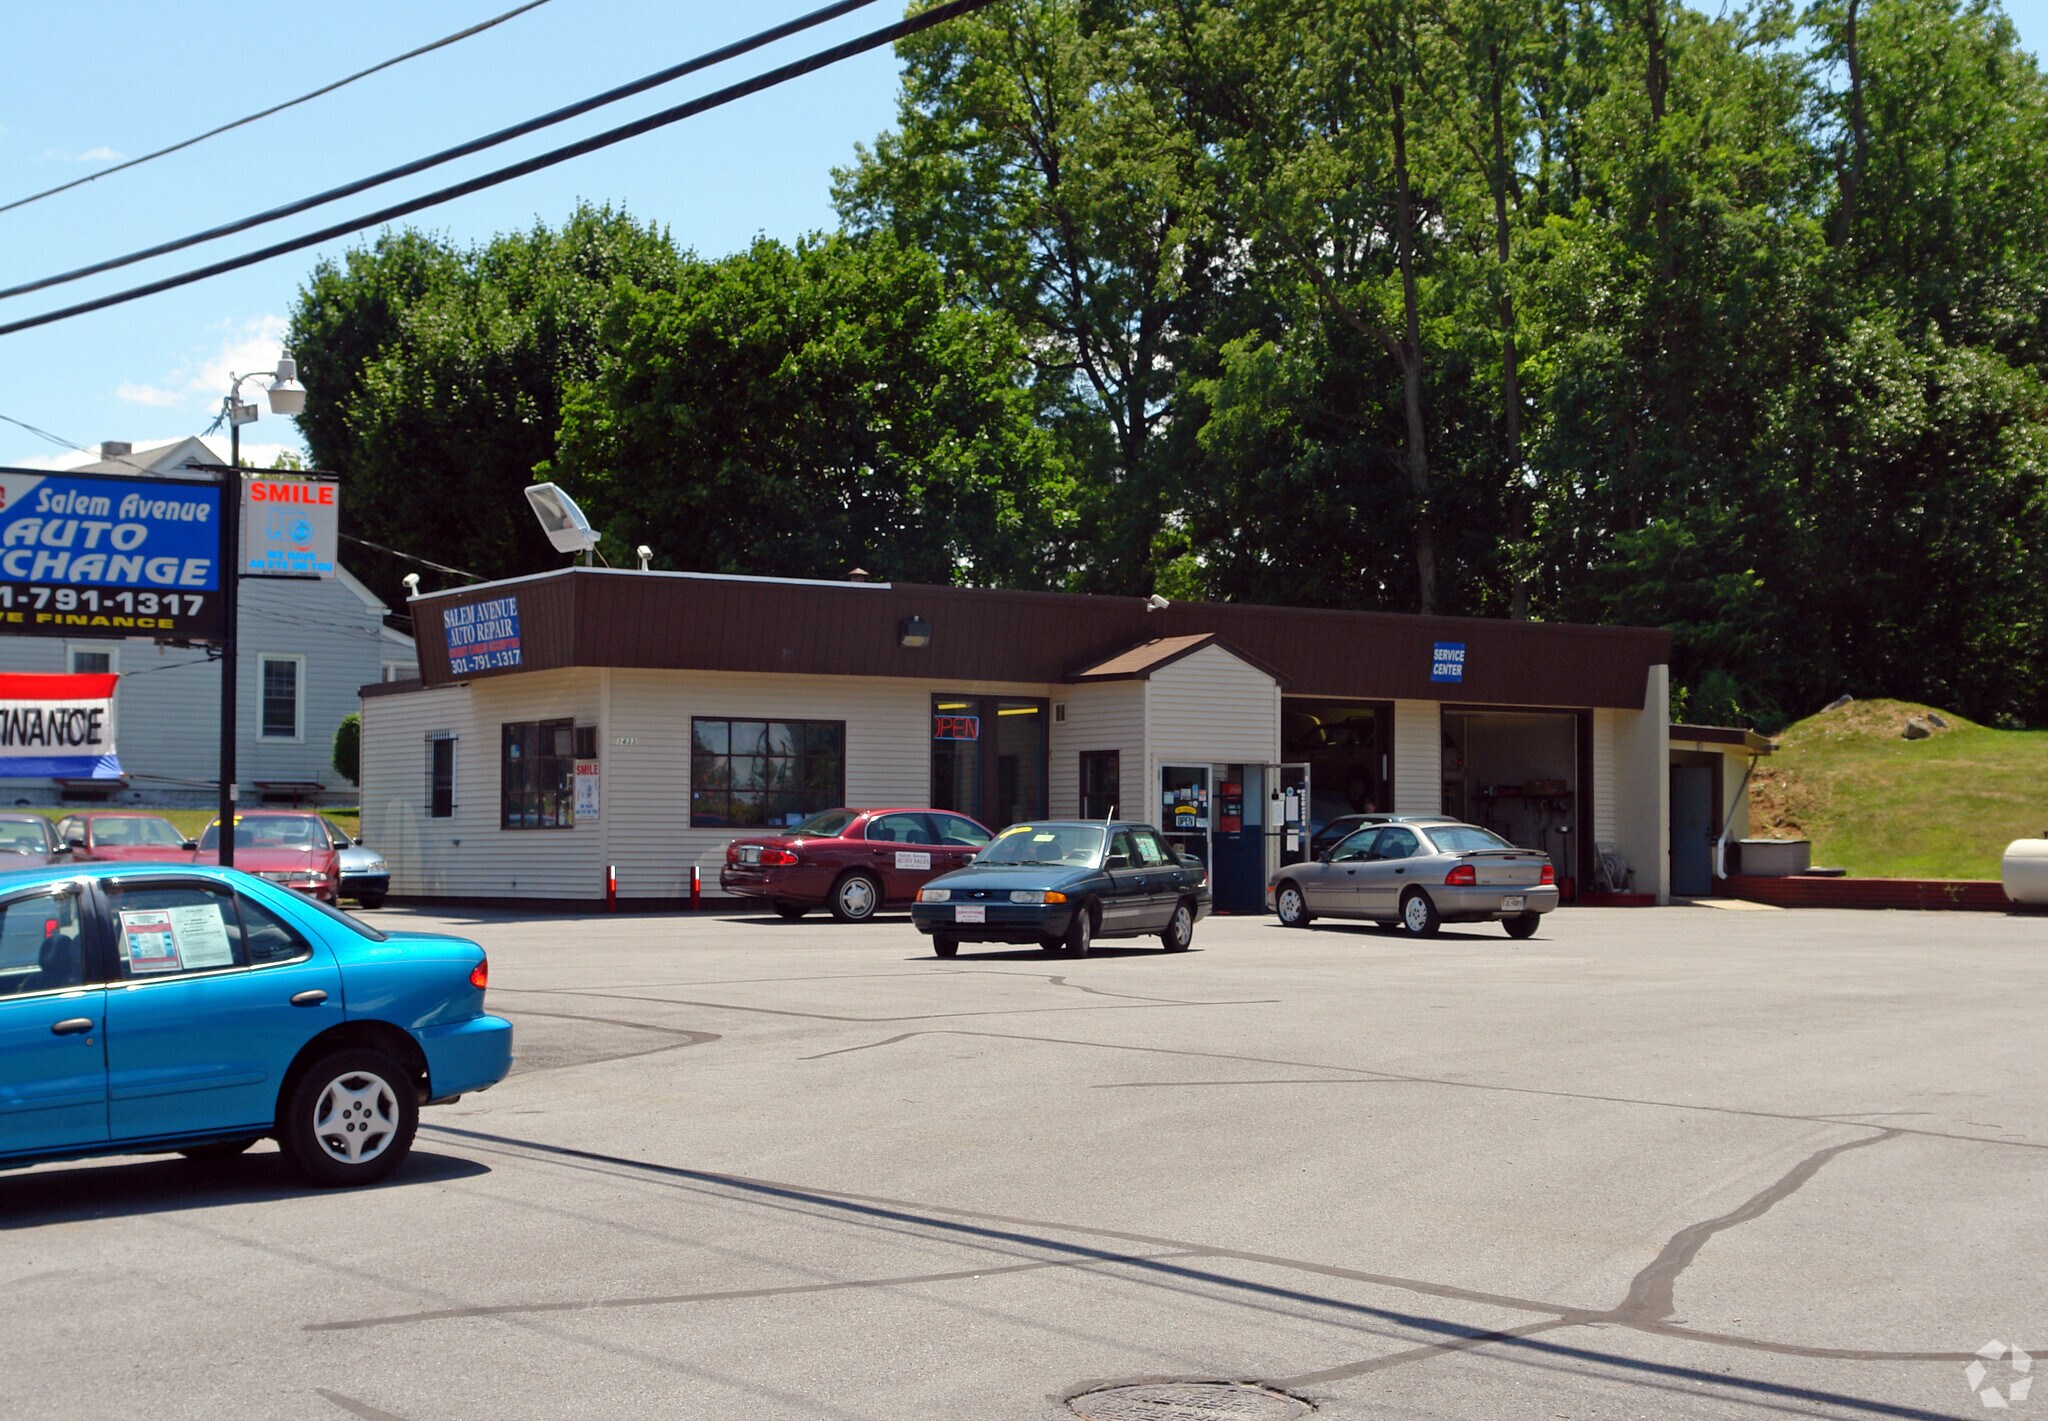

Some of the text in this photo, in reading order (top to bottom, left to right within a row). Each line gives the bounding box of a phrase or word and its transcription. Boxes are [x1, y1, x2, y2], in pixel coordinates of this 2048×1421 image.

[36, 487, 111, 517] Salem
[119, 493, 211, 522] Avenue
[250, 482, 334, 505] SMILE
[3, 517, 148, 552] AUTO
[0, 548, 211, 586] CHANGE
[36, 613, 174, 629] FINANCE
[444, 598, 518, 629] SALEM AVENUE
[451, 619, 514, 647] AUTO REPAIR
[451, 650, 520, 675] 301-791-1317
[1433, 649, 1465, 662] SERVICE
[1433, 663, 1463, 676] CENTER
[0, 708, 104, 747] INANCE
[576, 764, 599, 776] SMILE
[1177, 816, 1194, 826] OPEN
